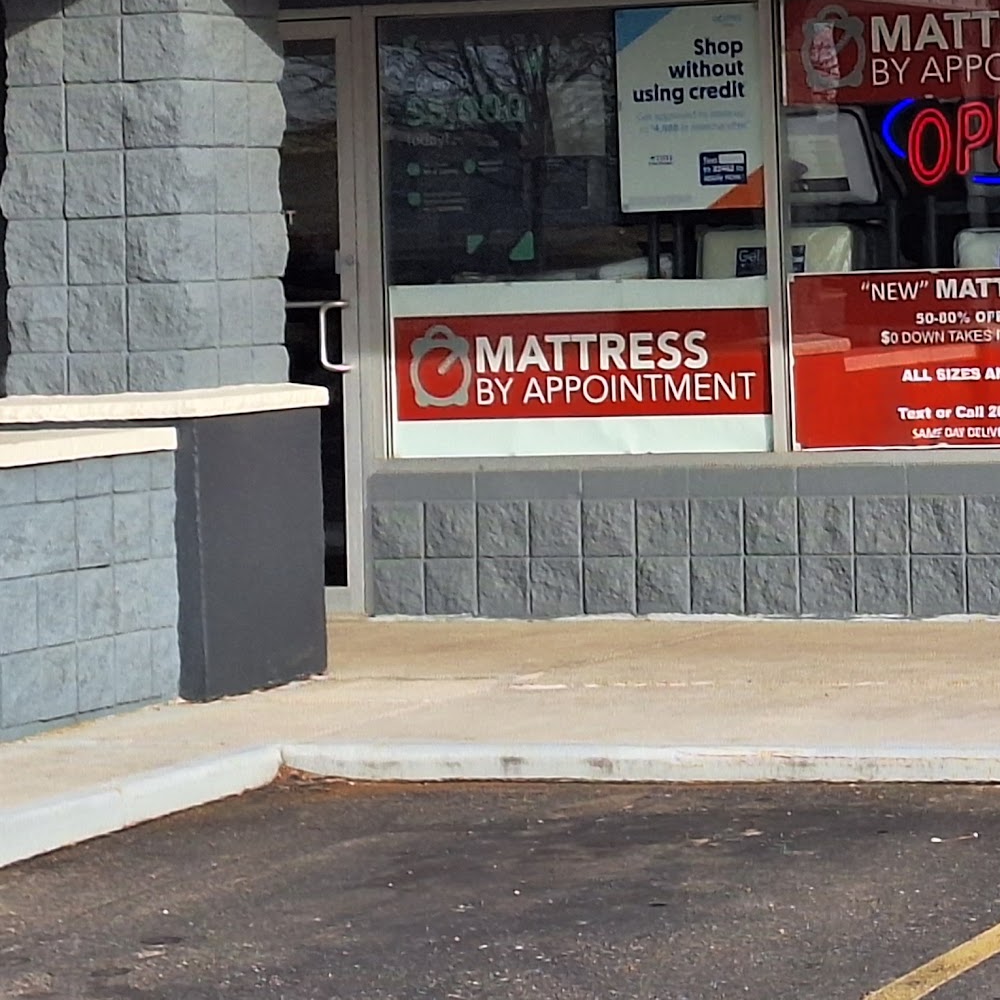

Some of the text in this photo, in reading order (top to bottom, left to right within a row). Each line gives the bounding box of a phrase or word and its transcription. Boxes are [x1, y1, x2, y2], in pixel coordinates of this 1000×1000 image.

[694, 38, 743, 58] Shop
[668, 60, 745, 79] without
[872, 56, 915, 86] BY
[633, 80, 745, 104] using credit
[881, 330, 899, 345] $0
[901, 331, 945, 344] DOWN
[948, 329, 992, 343] TAKES
[475, 331, 709, 374] MATTRESS
[901, 368, 933, 382] ALL
[935, 367, 981, 381] SIZES
[477, 371, 757, 405] BY APPOINTMENT
[897, 406, 932, 420] Text
[935, 408, 952, 419] or
[955, 405, 985, 418] Call
[911, 427, 943, 439] SAME
[944, 427, 965, 438] DAY
